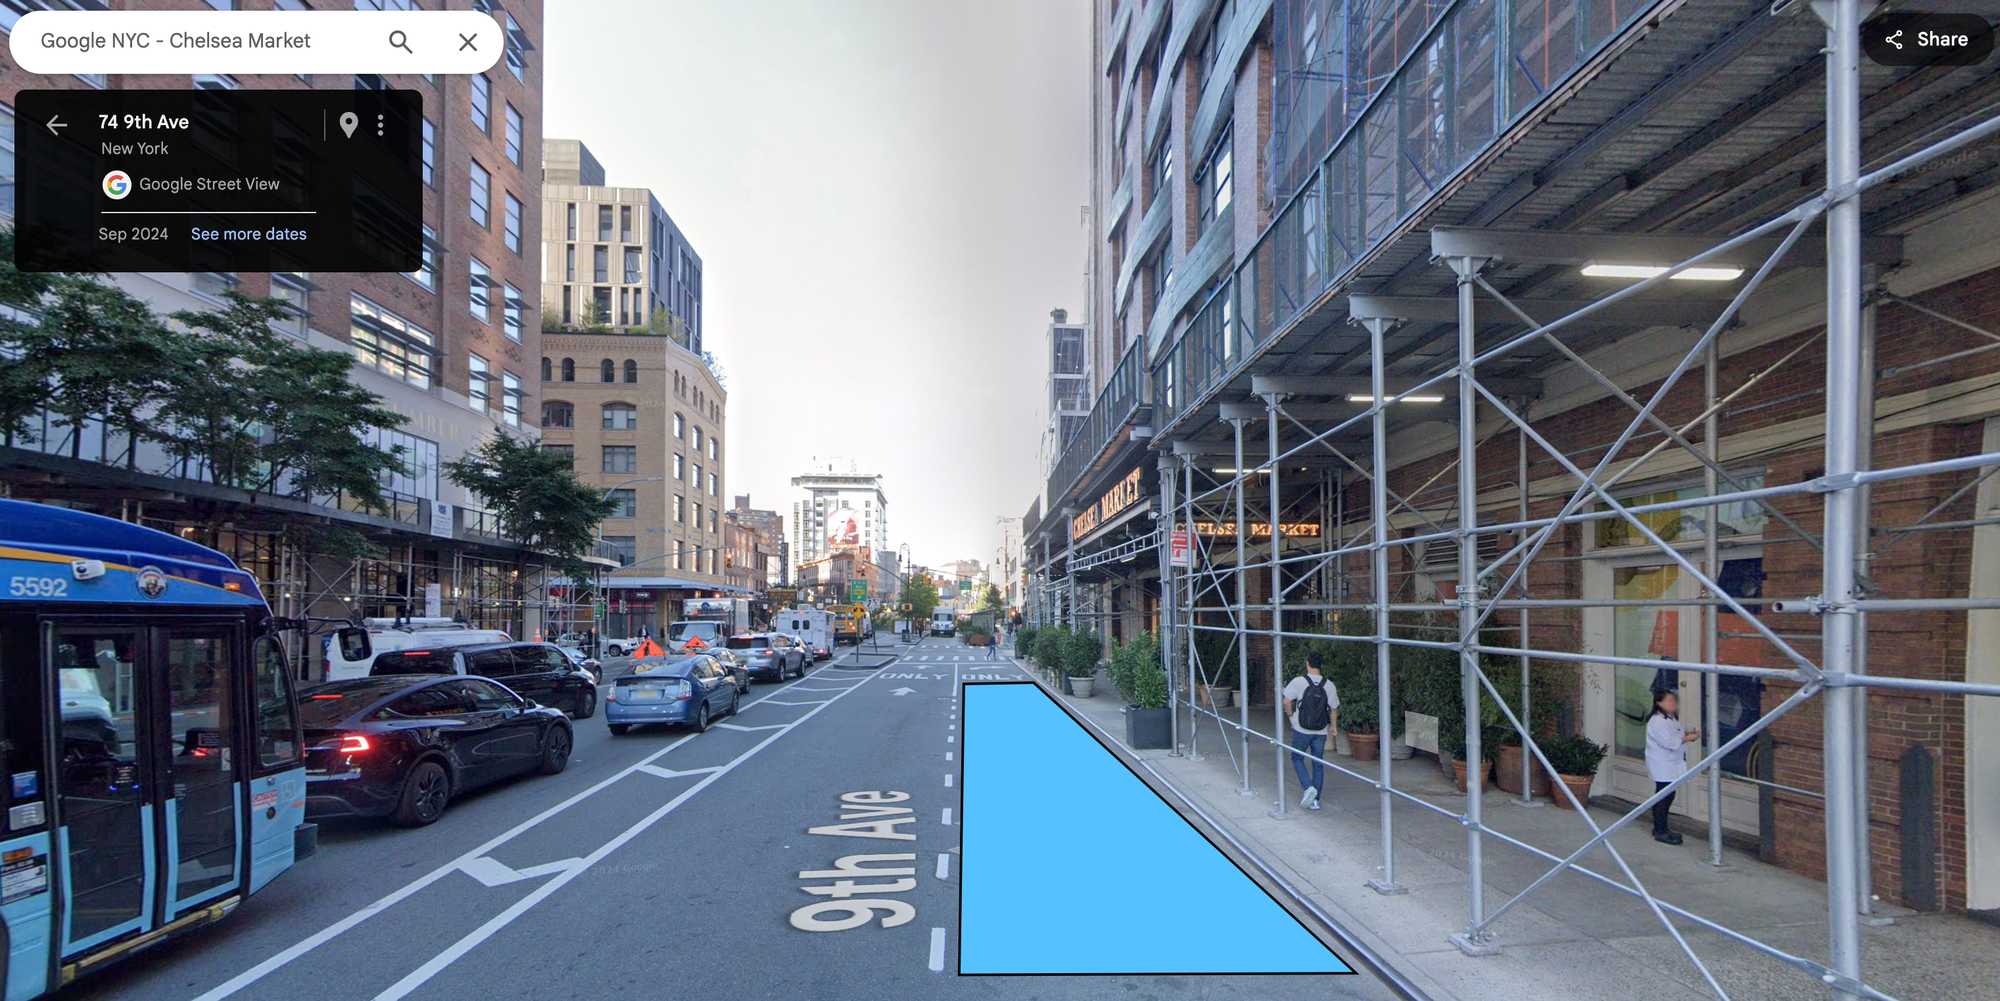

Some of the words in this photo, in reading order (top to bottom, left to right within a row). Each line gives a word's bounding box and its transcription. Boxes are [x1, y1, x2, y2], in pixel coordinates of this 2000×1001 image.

[1073, 501, 1099, 541] CHELSEA
[1101, 466, 1140, 523] MARKET
[9, 576, 69, 597] 5592
[878, 672, 950, 681] ONLY
[961, 673, 1025, 681] ONLY
